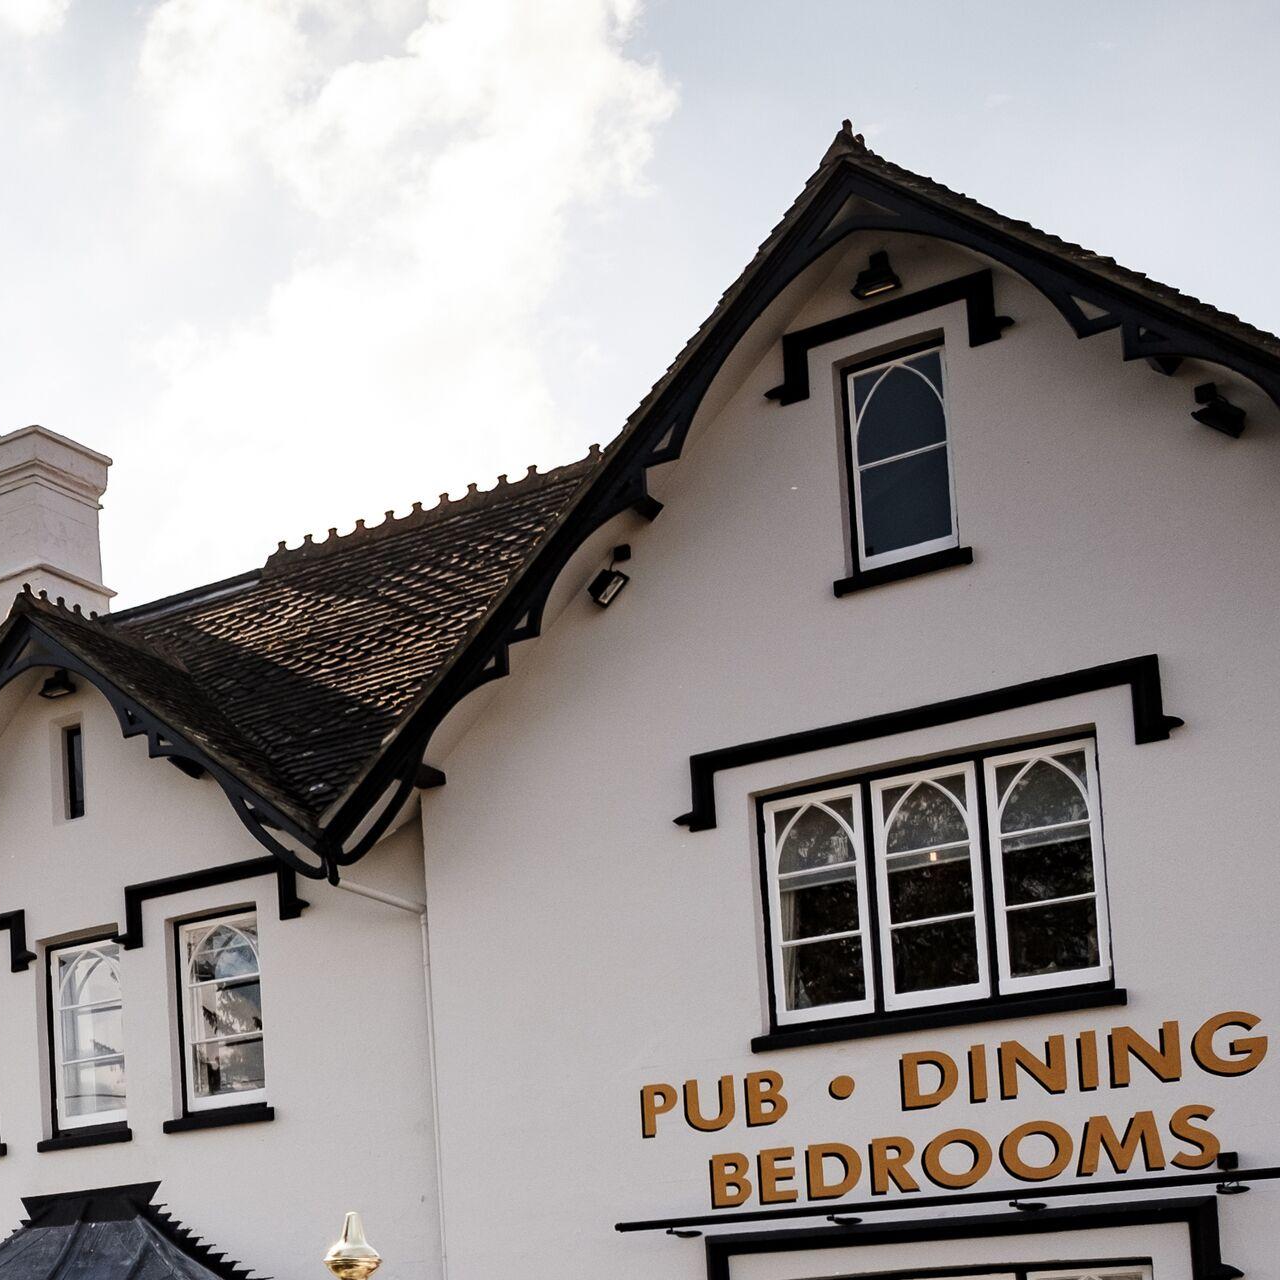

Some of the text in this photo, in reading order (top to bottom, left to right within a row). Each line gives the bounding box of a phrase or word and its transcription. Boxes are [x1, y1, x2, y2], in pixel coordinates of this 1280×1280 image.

[640, 1010, 1269, 1139] PUB DINING
[708, 1104, 1222, 1209] BEDROOMS
